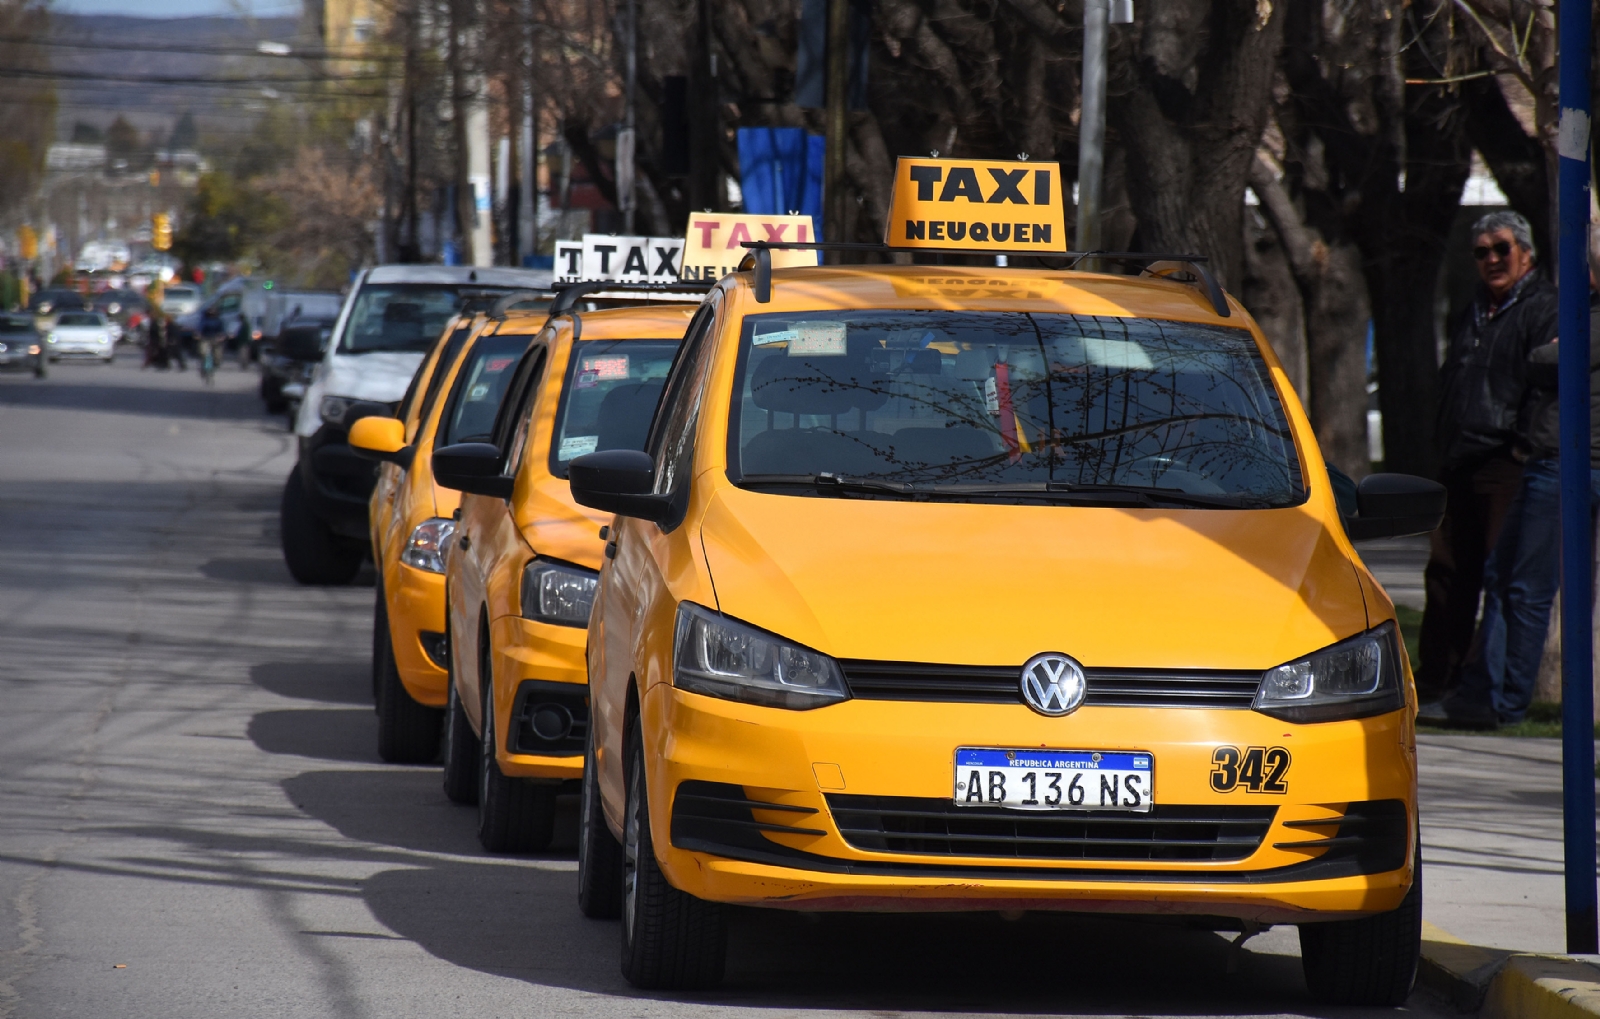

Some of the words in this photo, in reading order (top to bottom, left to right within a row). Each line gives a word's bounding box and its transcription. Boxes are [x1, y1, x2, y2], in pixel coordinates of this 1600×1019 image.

[909, 165, 1051, 206] TAXI
[694, 221, 808, 252] TAXI
[905, 219, 1053, 244] NEUQUEN
[1009, 759, 1053, 768] REPUBLICA
[1054, 760, 1099, 769] ARGENTINA
[1210, 745, 1292, 795] 342
[965, 770, 1007, 804] AB
[1021, 771, 1086, 806] 136
[1100, 774, 1142, 808] NS
